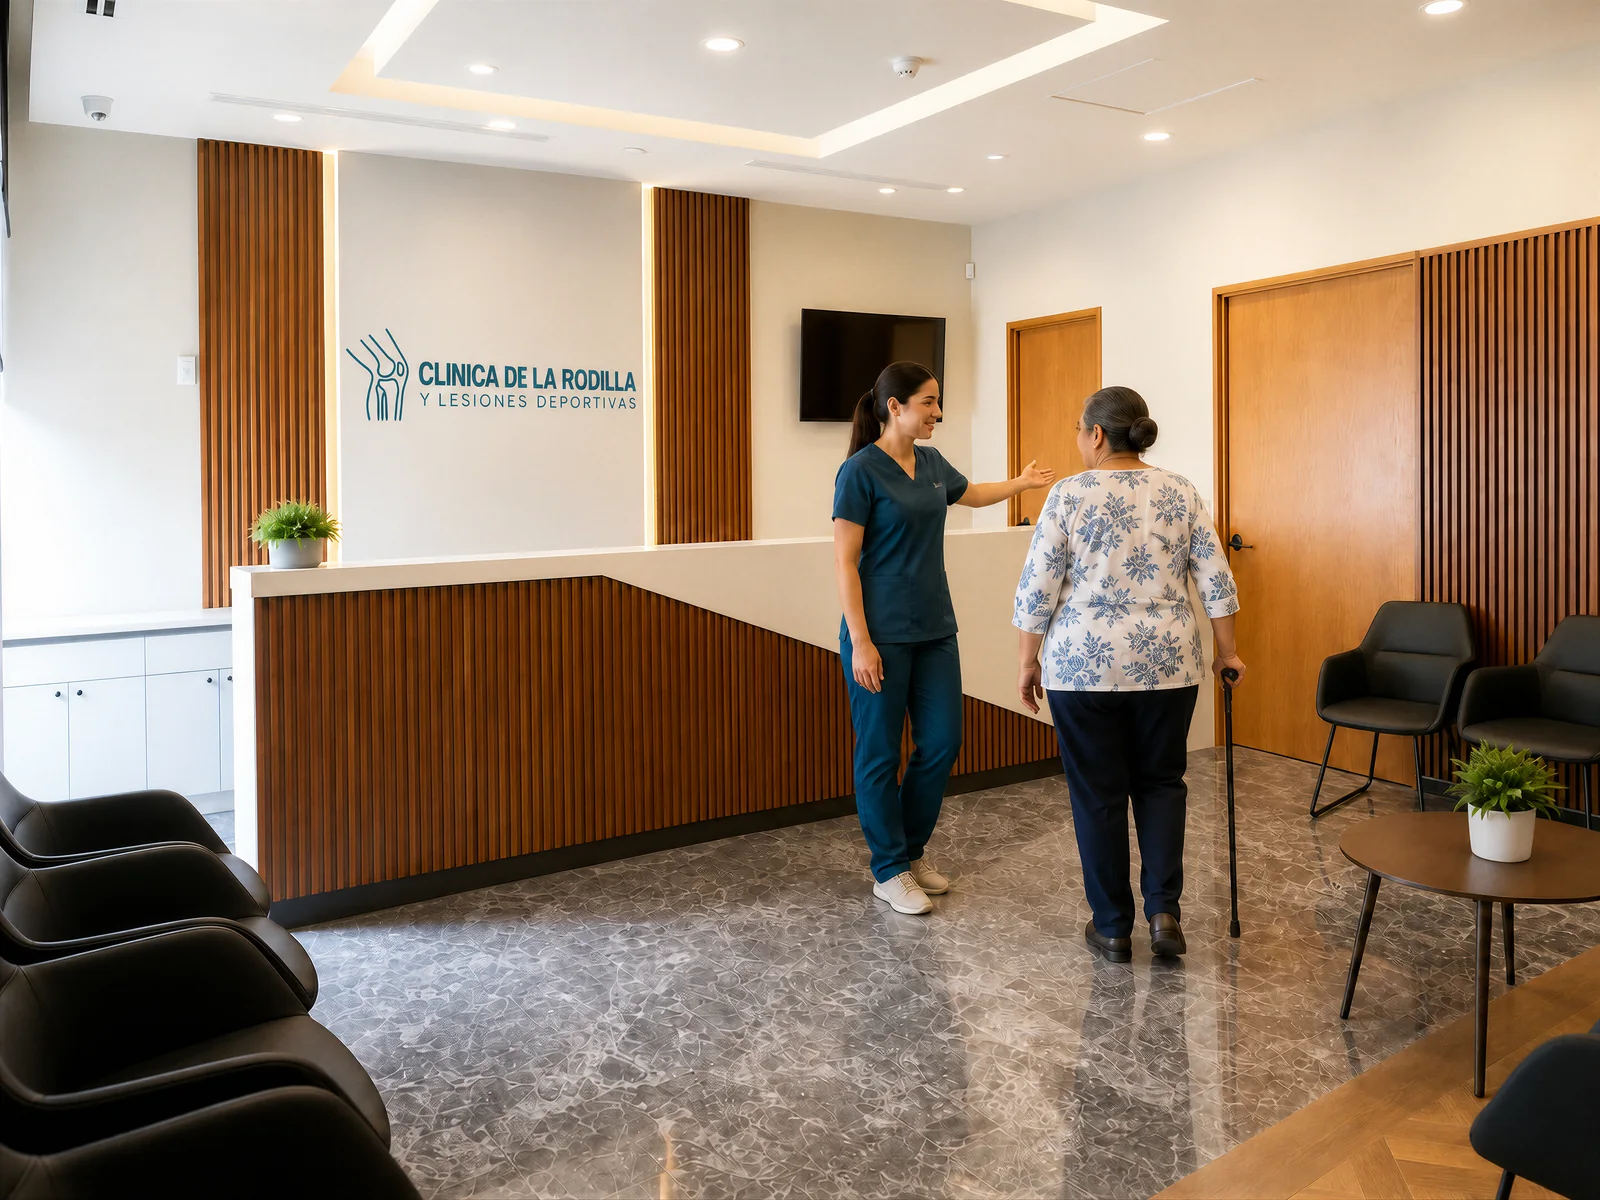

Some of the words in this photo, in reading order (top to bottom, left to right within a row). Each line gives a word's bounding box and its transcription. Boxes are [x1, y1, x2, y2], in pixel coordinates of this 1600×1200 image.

[418, 360, 500, 388] CLINICA
[505, 365, 528, 389] DE
[532, 366, 558, 390] LA
[561, 368, 637, 393] RODILLA
[419, 392, 430, 407] Y
[438, 392, 528, 408] LESIONES
[536, 395, 637, 410] DEPORTIVAS
